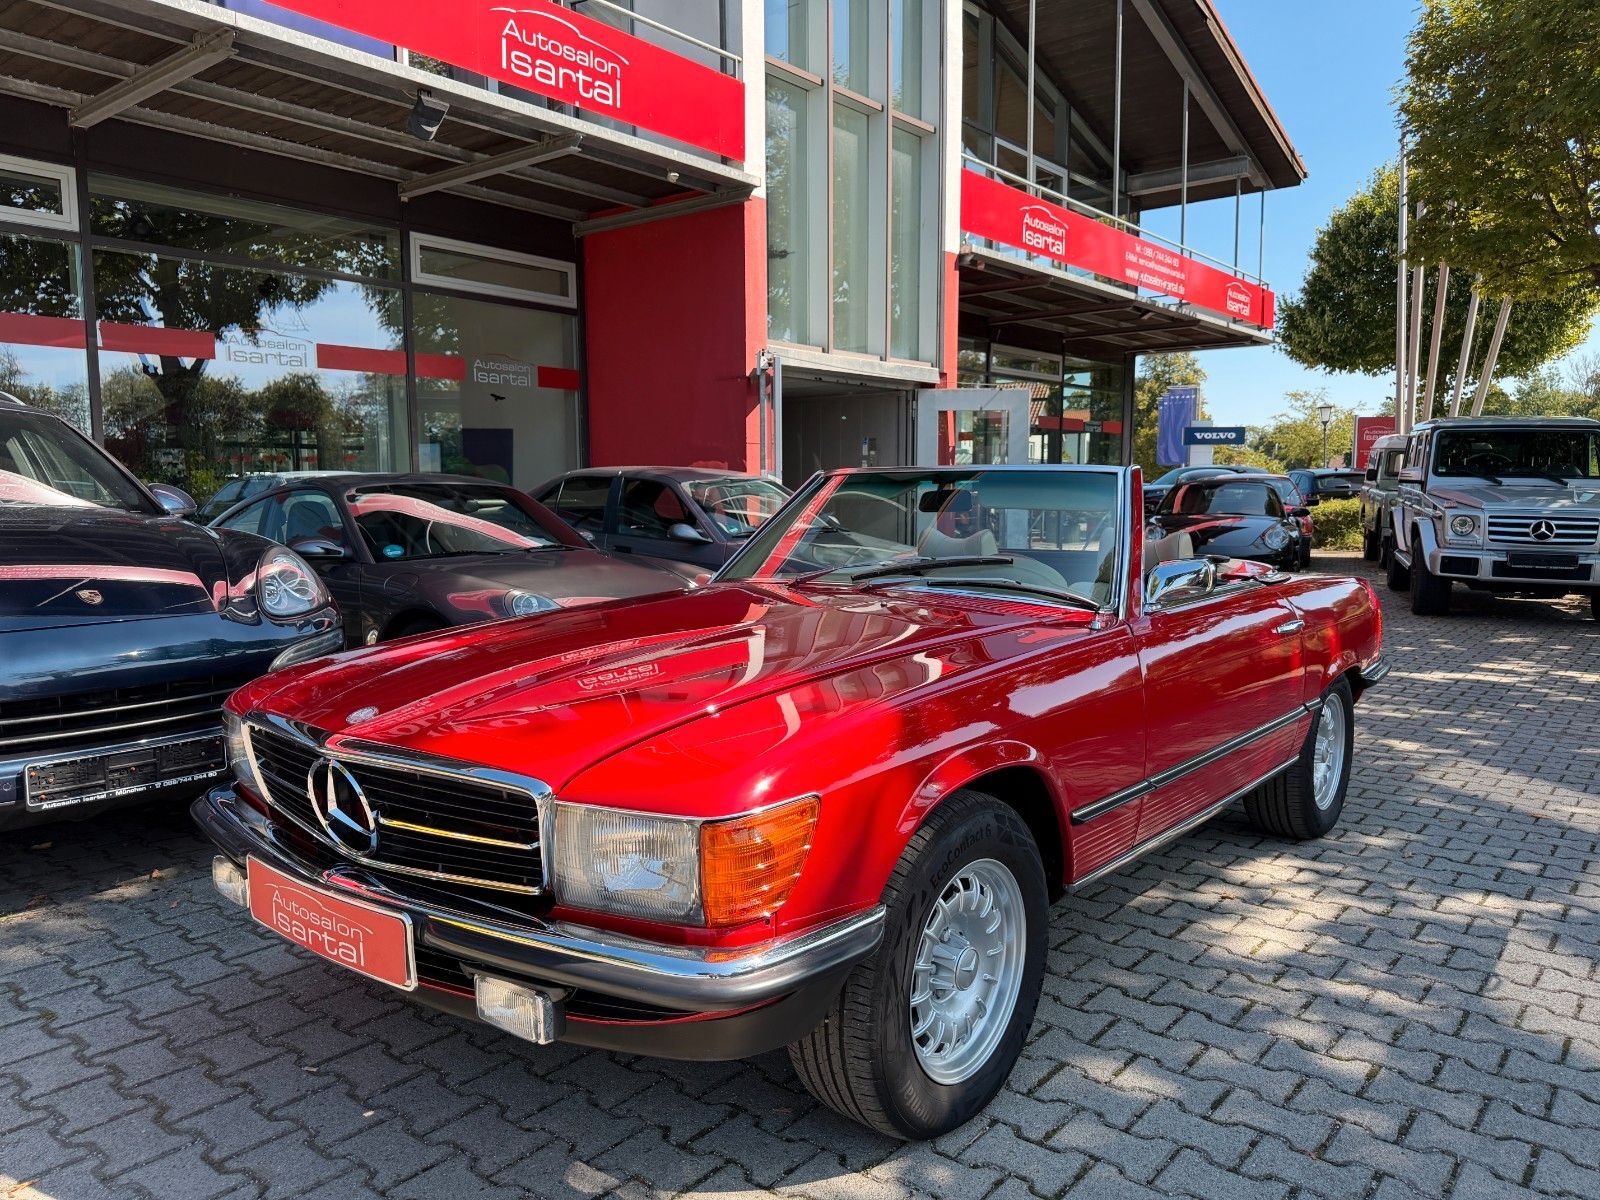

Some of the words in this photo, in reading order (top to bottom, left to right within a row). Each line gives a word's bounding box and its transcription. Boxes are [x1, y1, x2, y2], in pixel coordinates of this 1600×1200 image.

[501, 18, 621, 79] Autosalon
[501, 37, 621, 109] Isartal
[1023, 212, 1066, 237] Autosalon
[1022, 224, 1066, 256] Isartal
[1226, 294, 1251, 317] Isartal
[226, 345, 308, 368] Isartal
[473, 359, 531, 373] Autosalon
[473, 367, 531, 388] Isartal
[1194, 432, 1237, 440] VOLVO
[42, 798, 81, 810] Autosalon
[115, 785, 147, 797] München
[929, 827, 984, 888] EcoContact
[985, 823, 992, 838] 6
[272, 889, 363, 942] Autosalon
[272, 901, 365, 967] Isartal
